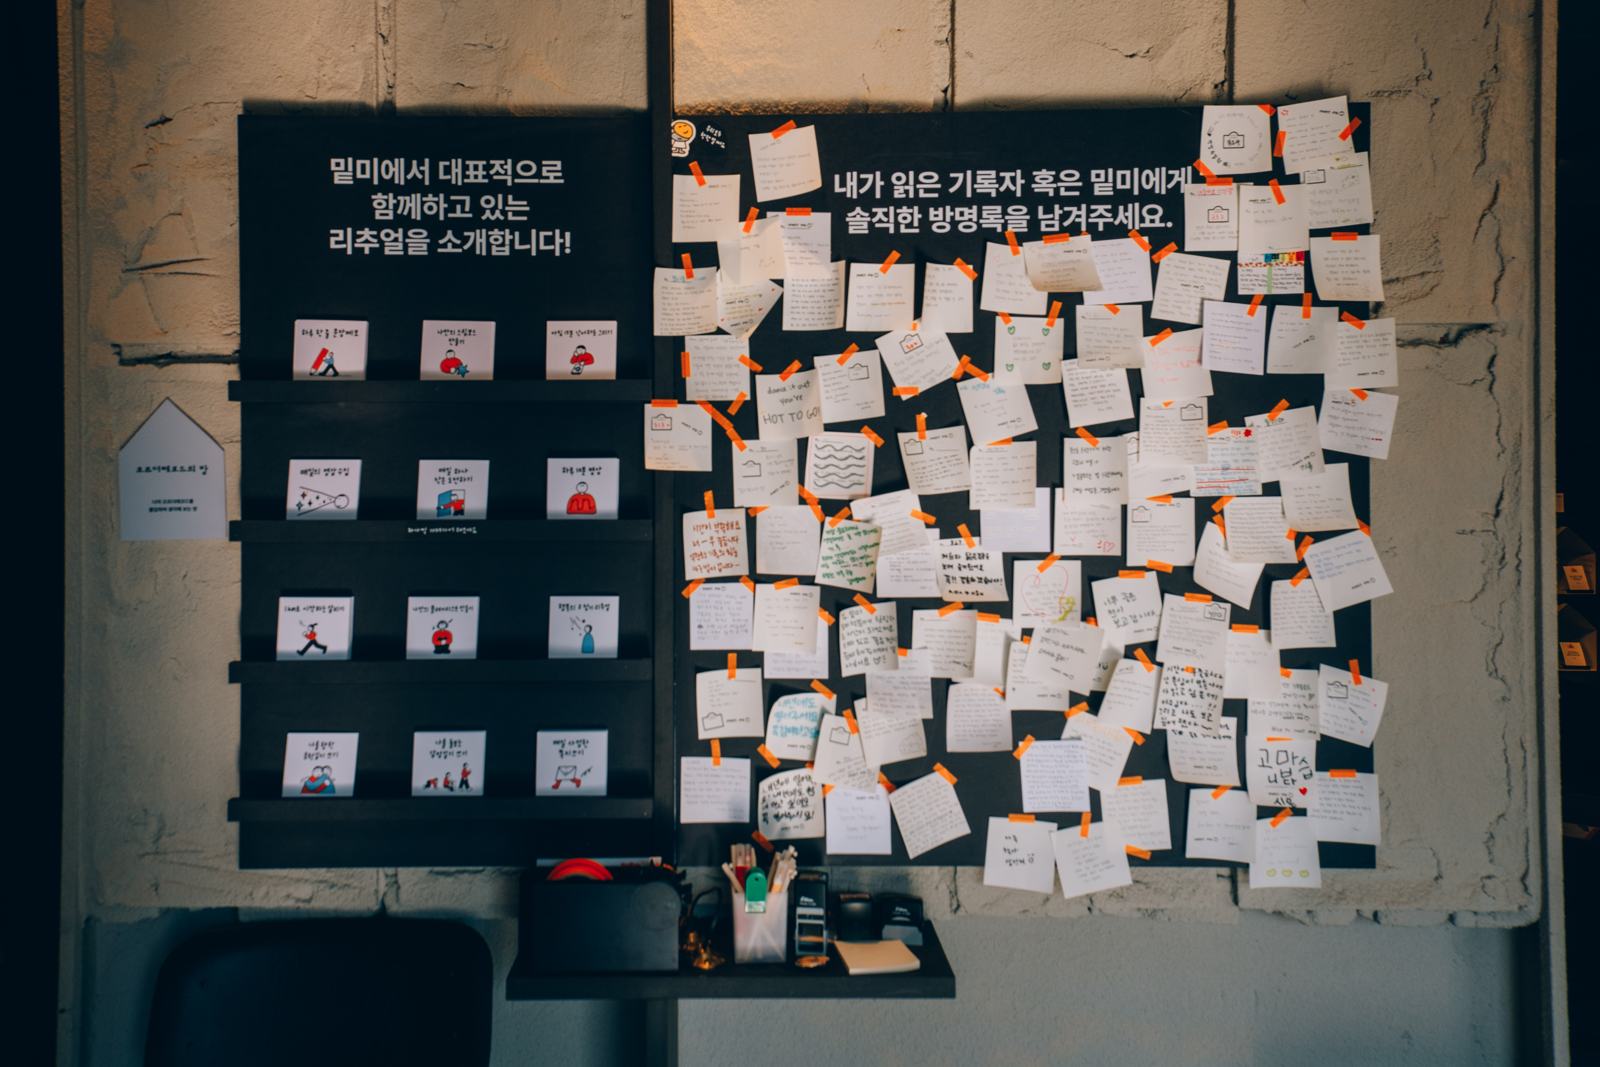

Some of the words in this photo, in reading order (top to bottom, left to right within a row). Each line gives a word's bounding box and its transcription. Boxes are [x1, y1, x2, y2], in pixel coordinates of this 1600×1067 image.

[329, 156, 430, 186] 밑미에서
[438, 157, 565, 186] 대표적으로
[833, 170, 884, 199] 내가
[891, 170, 941, 199] 읽은
[948, 169, 1025, 198] 기록자
[1031, 168, 1082, 197] 혹은
[371, 192, 472, 221] 함께하고
[480, 192, 530, 220] 있는
[845, 206, 922, 235] 솔직한
[928, 205, 1031, 233] 방명록을
[1037, 203, 1174, 232] 남겨주세요.
[328, 227, 431, 256] 리추얼을
[436, 227, 572, 256] 소개합니다!
[763, 412, 785, 424] HOT
[788, 410, 804, 422] TO
